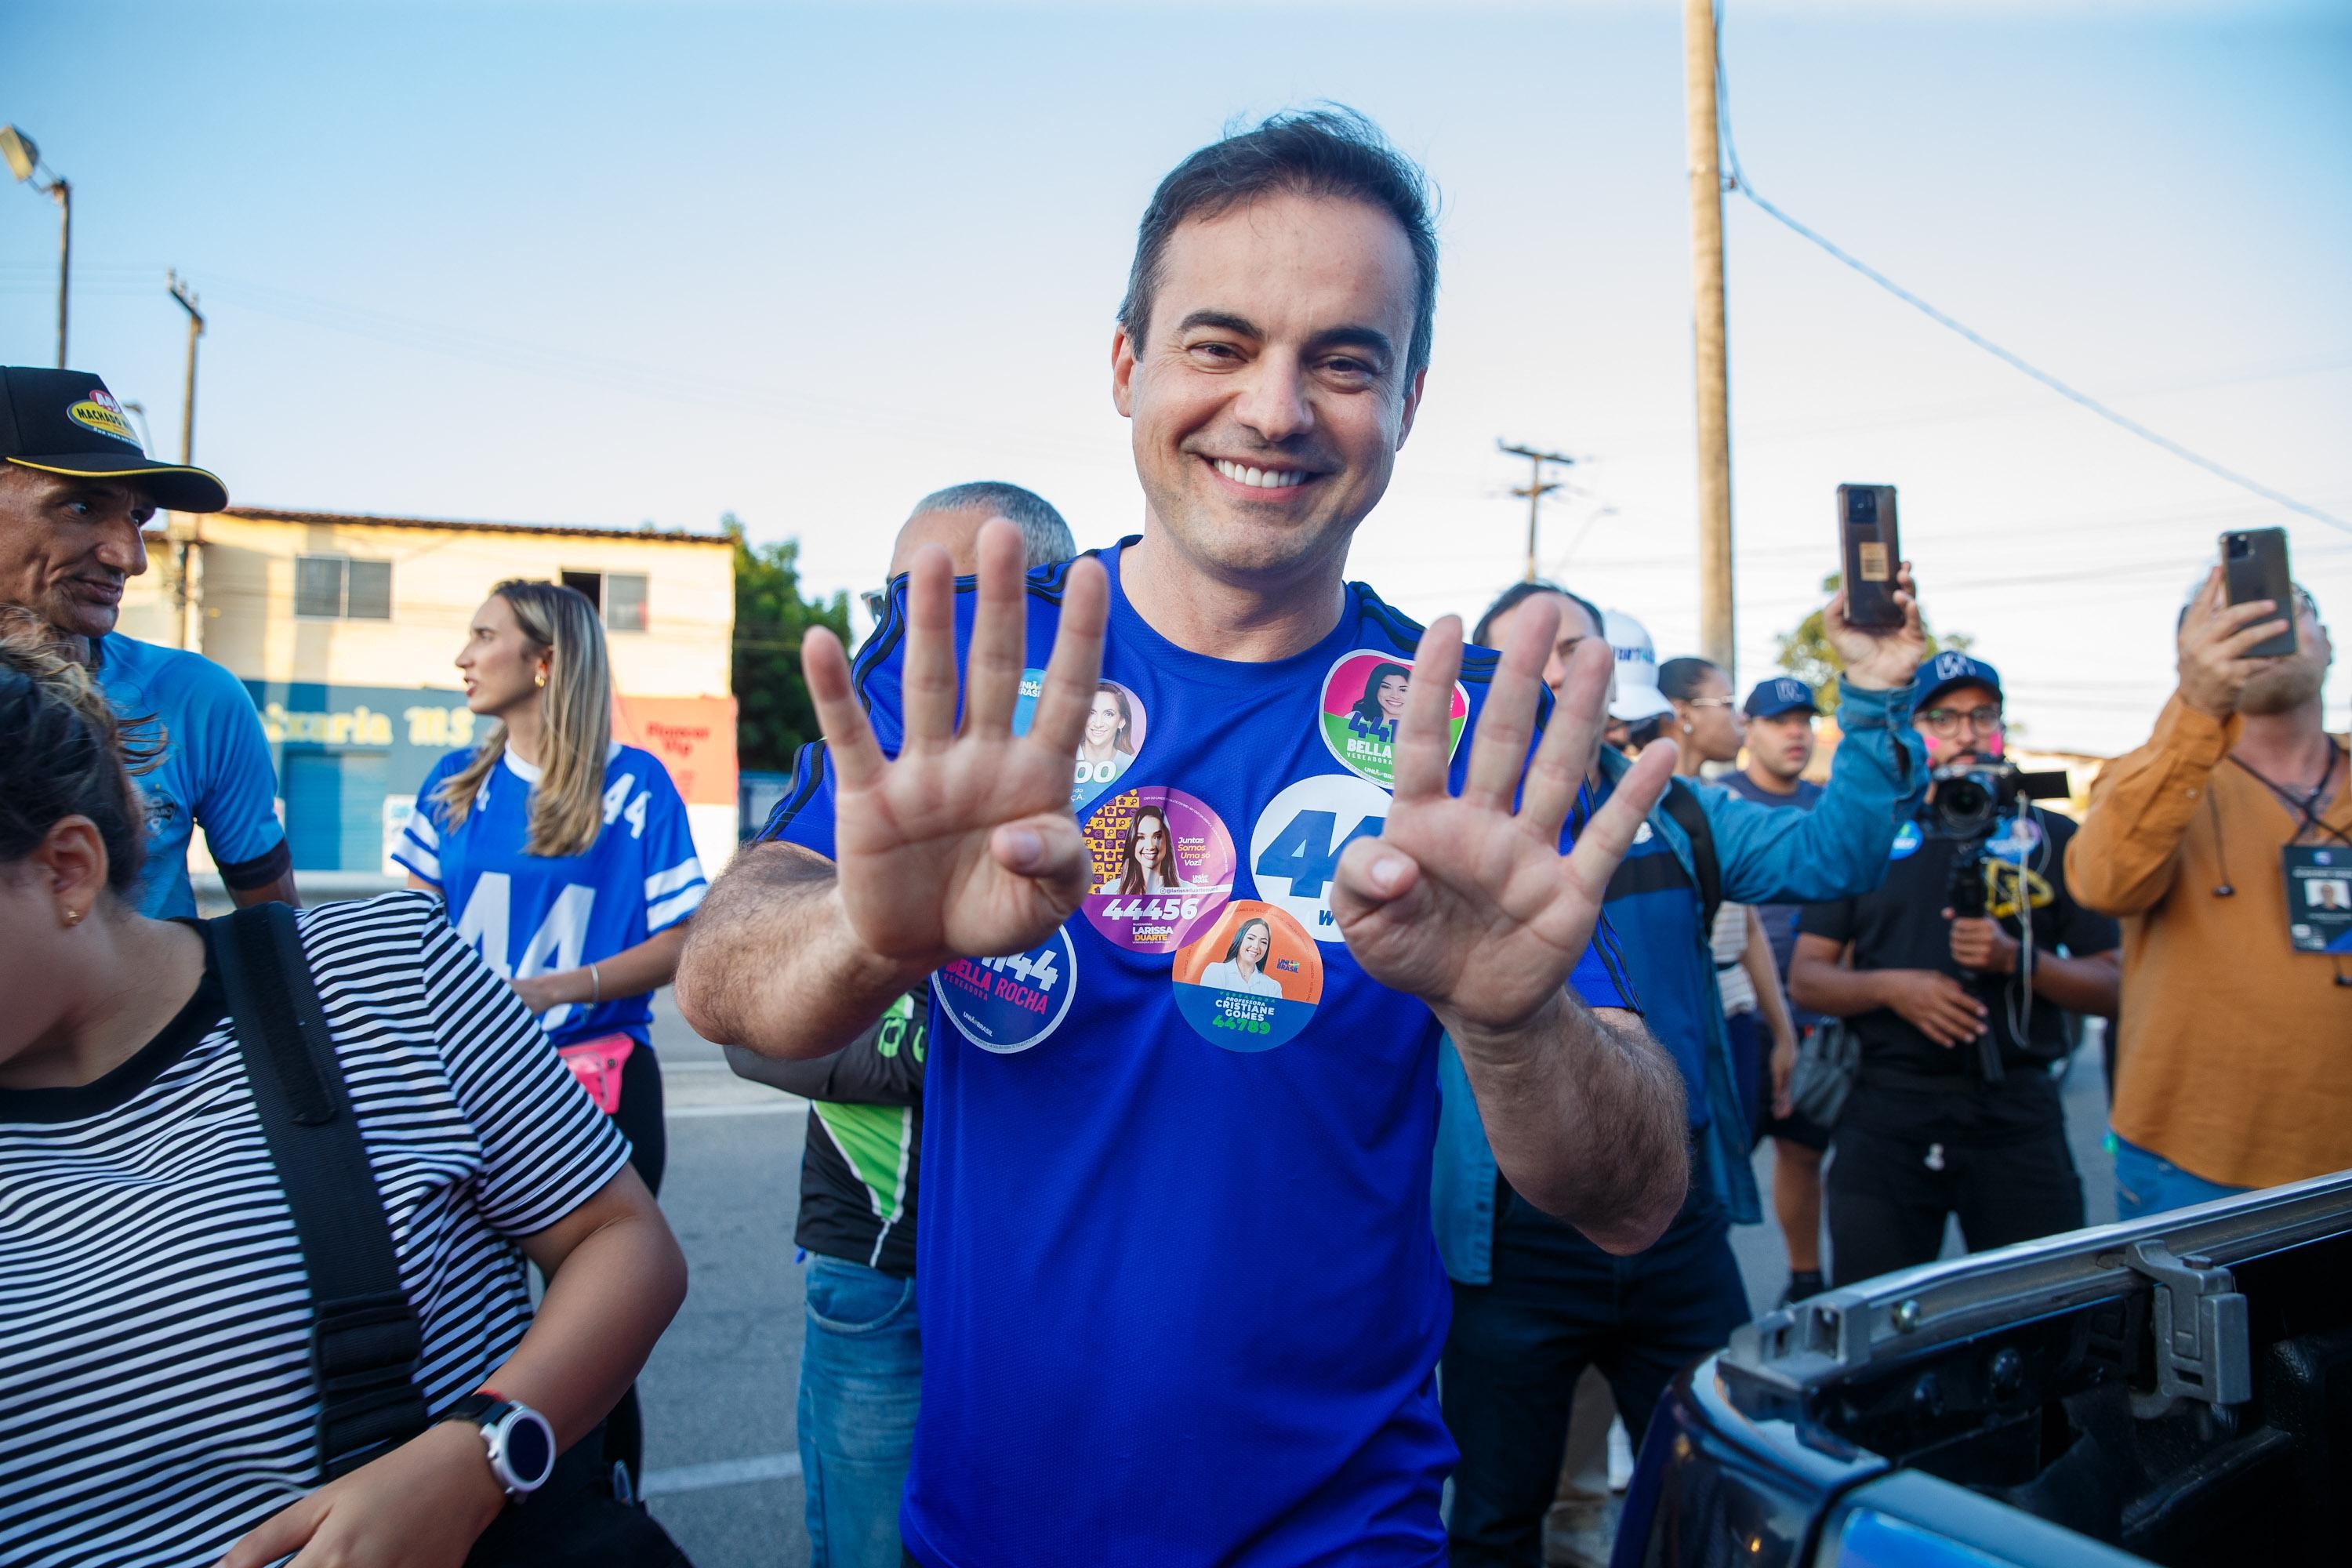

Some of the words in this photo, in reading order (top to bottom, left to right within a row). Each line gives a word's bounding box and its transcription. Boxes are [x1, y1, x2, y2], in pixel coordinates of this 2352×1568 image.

[77, 408, 122, 426] MACHADO
[1348, 712, 1399, 743] 441
[1347, 738, 1392, 759] BELLA
[1346, 752, 1393, 765] VEREADORA
[1074, 760, 1116, 784] 00
[1071, 793, 1085, 802] ÇA.
[1102, 898, 1200, 920] 44456
[1132, 926, 1174, 935] LARISSA
[455, 871, 597, 1032] 44
[1276, 964, 1299, 974] BRASIL
[944, 973, 989, 1001] VEREADORA
[945, 958, 993, 992] BELLA
[994, 978, 1048, 1015] ROCHA
[1219, 991, 1276, 1004] VEREADORA
[1225, 996, 1265, 1007] PROFESSORA
[1215, 999, 1275, 1016] CRISTIANE
[1225, 1008, 1265, 1022] GOMES
[1212, 1014, 1271, 1035] 44789
